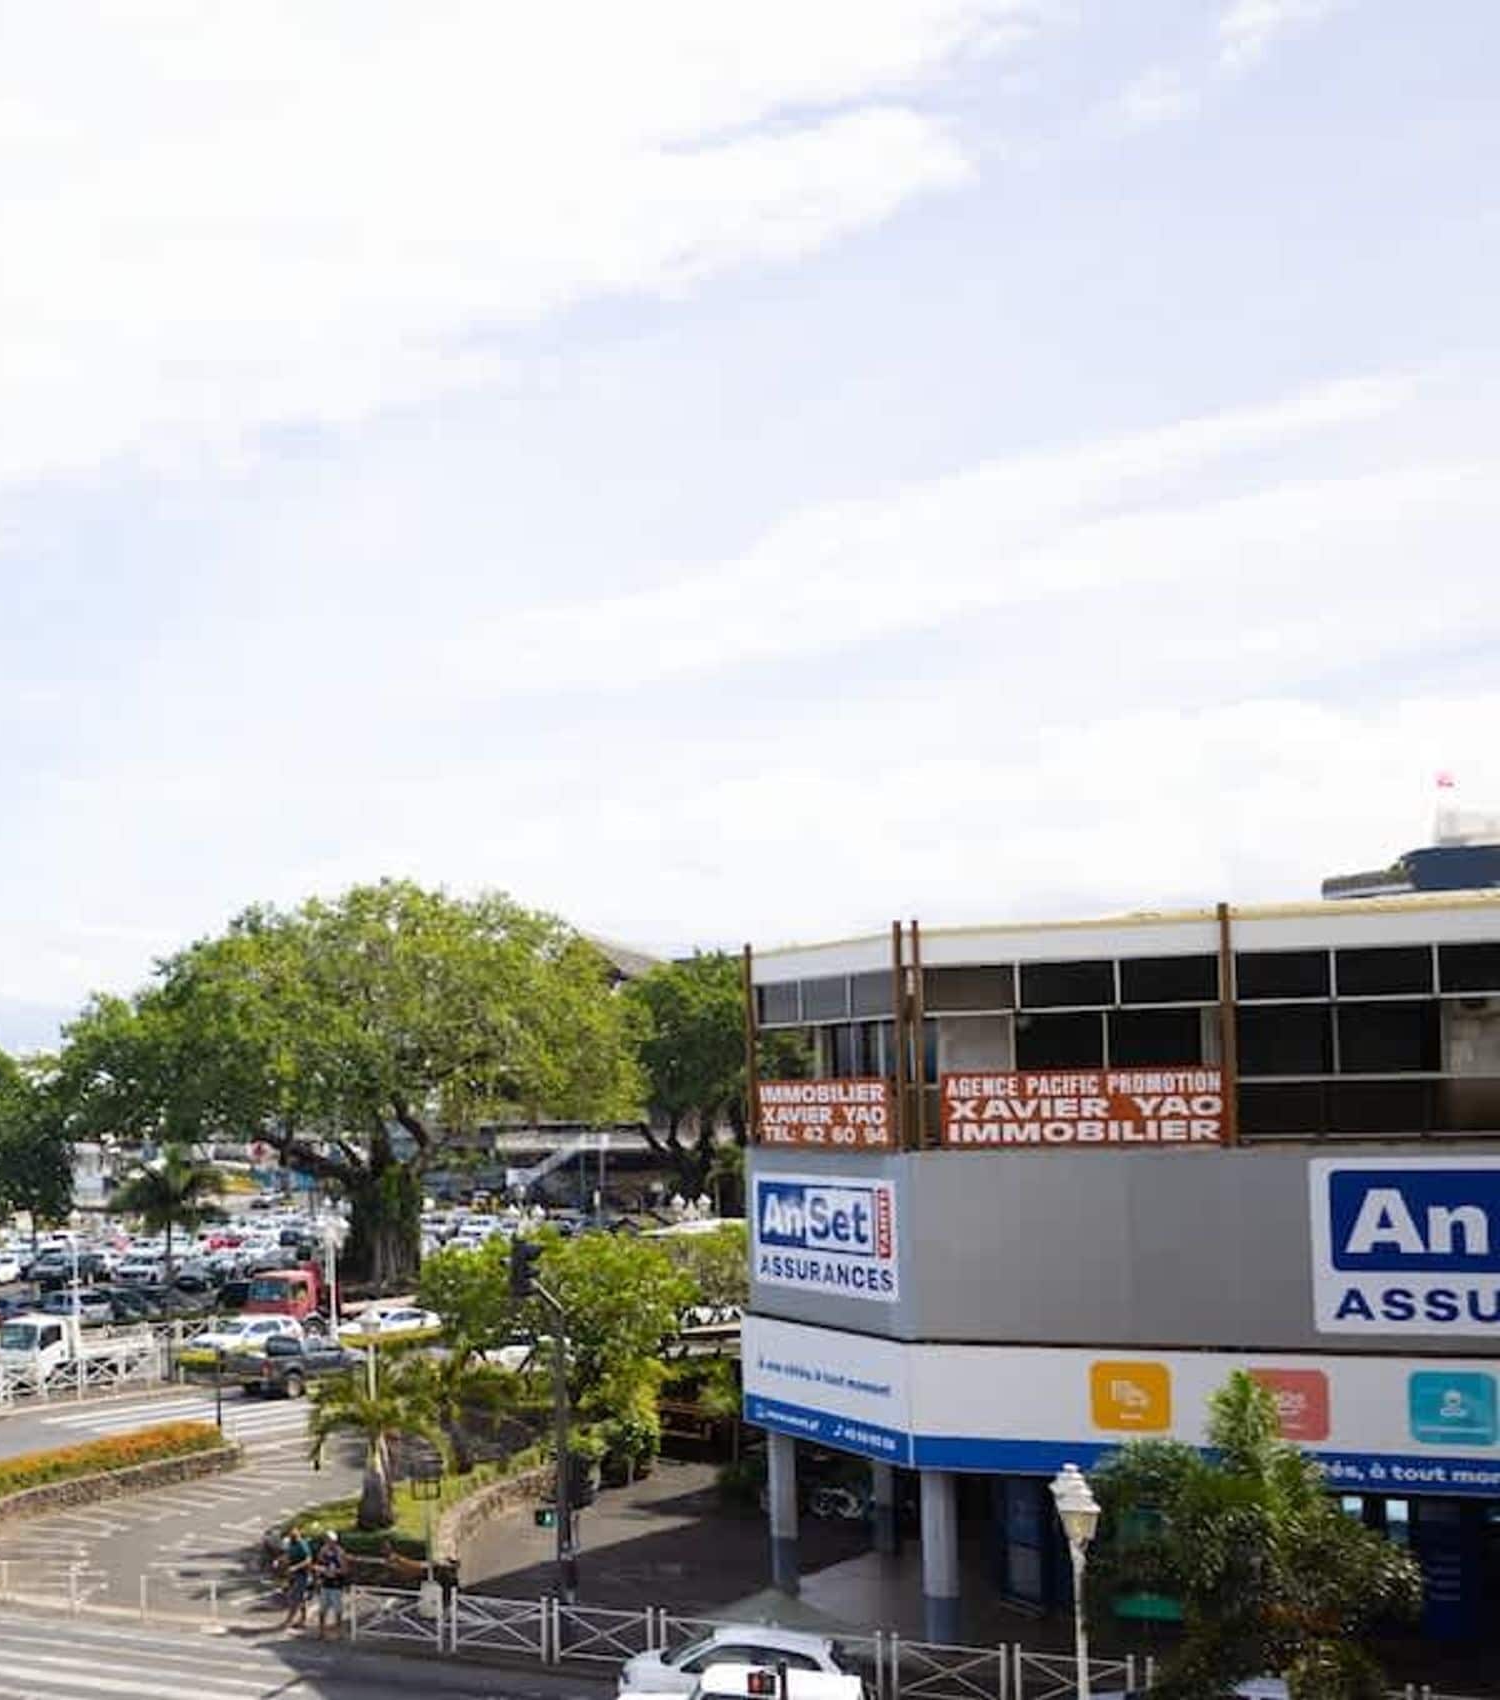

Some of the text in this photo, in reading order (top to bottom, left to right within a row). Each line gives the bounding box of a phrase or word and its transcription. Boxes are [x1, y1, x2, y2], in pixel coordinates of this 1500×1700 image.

[760, 1083, 885, 1103] IMMOBILIER
[946, 1071, 1221, 1097] AGENCE PACIFIC PROMOTION
[761, 1104, 886, 1124] XAVIER YAO
[951, 1096, 1223, 1119] XAVIER YAO
[948, 1119, 1221, 1142] IMMOBILIER
[763, 1192, 868, 1244] AnSet
[1345, 1187, 1489, 1255] An
[760, 1255, 894, 1292] ASSURANCES
[1335, 1287, 1500, 1323] ASSU
[1391, 1465, 1447, 1482] tout
